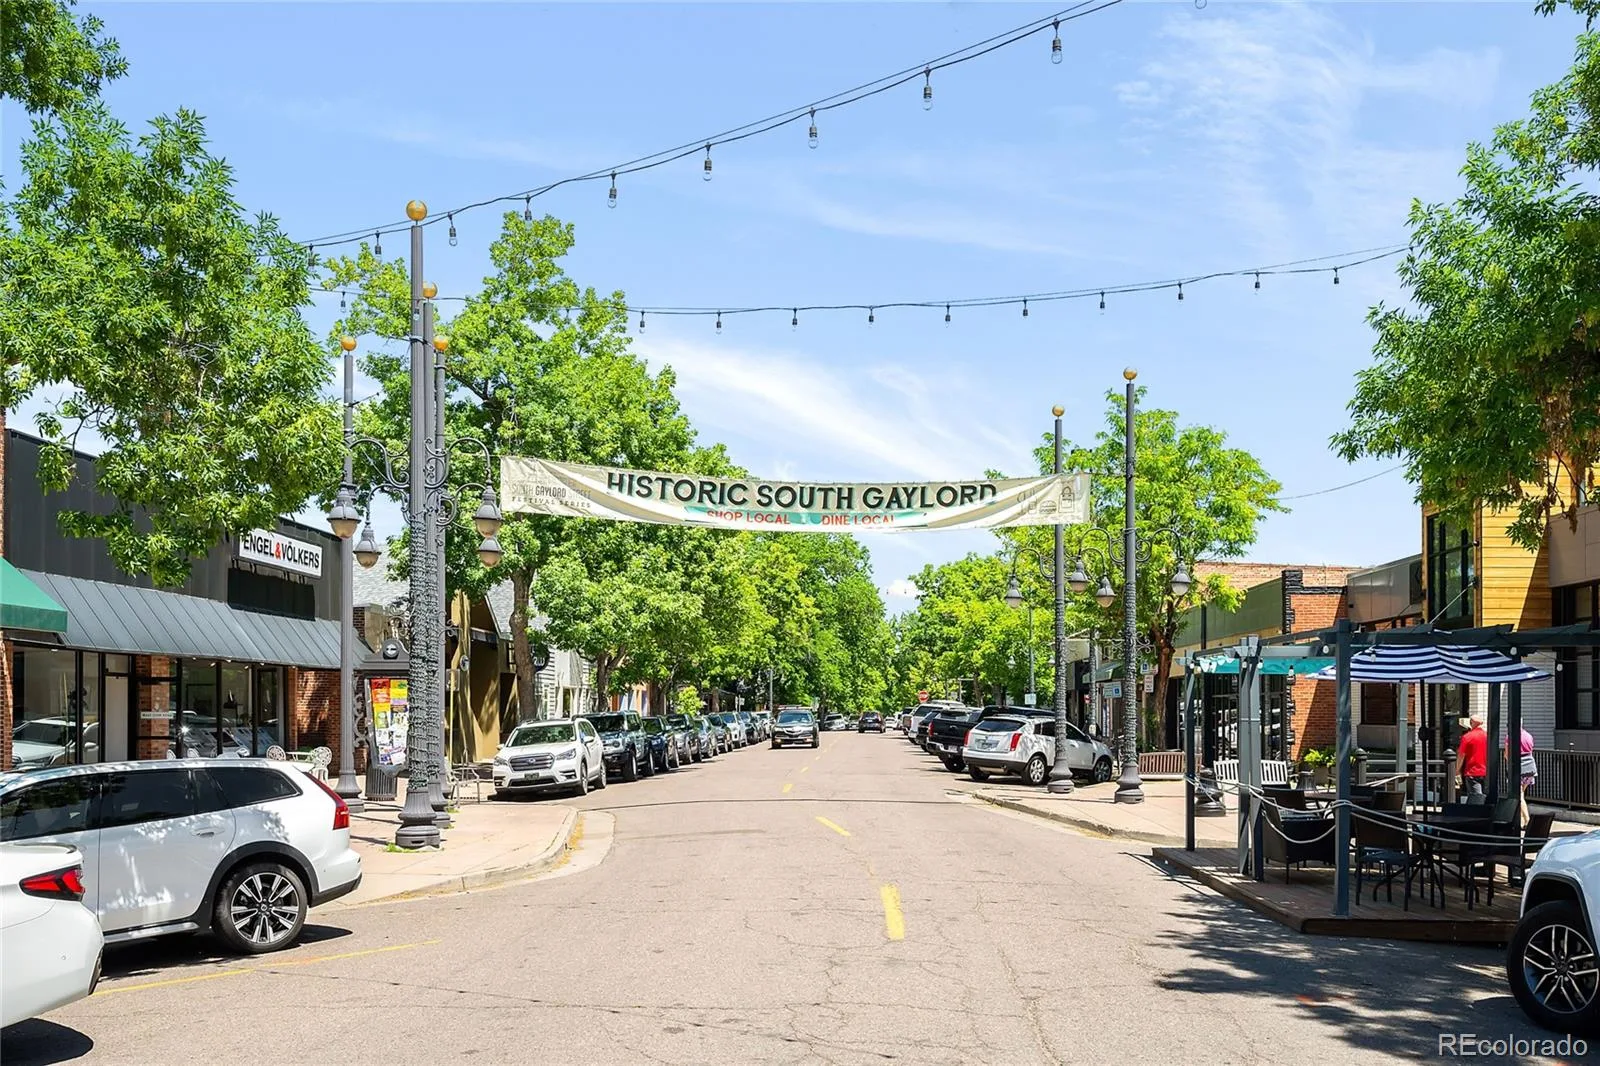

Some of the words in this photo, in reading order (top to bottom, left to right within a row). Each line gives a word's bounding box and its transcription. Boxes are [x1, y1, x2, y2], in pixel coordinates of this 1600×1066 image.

[535, 484, 566, 499] GAYLORD
[607, 471, 748, 507] HISTORIC
[756, 484, 853, 510] SOUTH
[862, 484, 997, 510] GAYLORD
[559, 500, 591, 508] SERIES
[707, 510, 743, 522] SHOP
[746, 512, 790, 525] LOCAL
[822, 514, 850, 526] DINE
